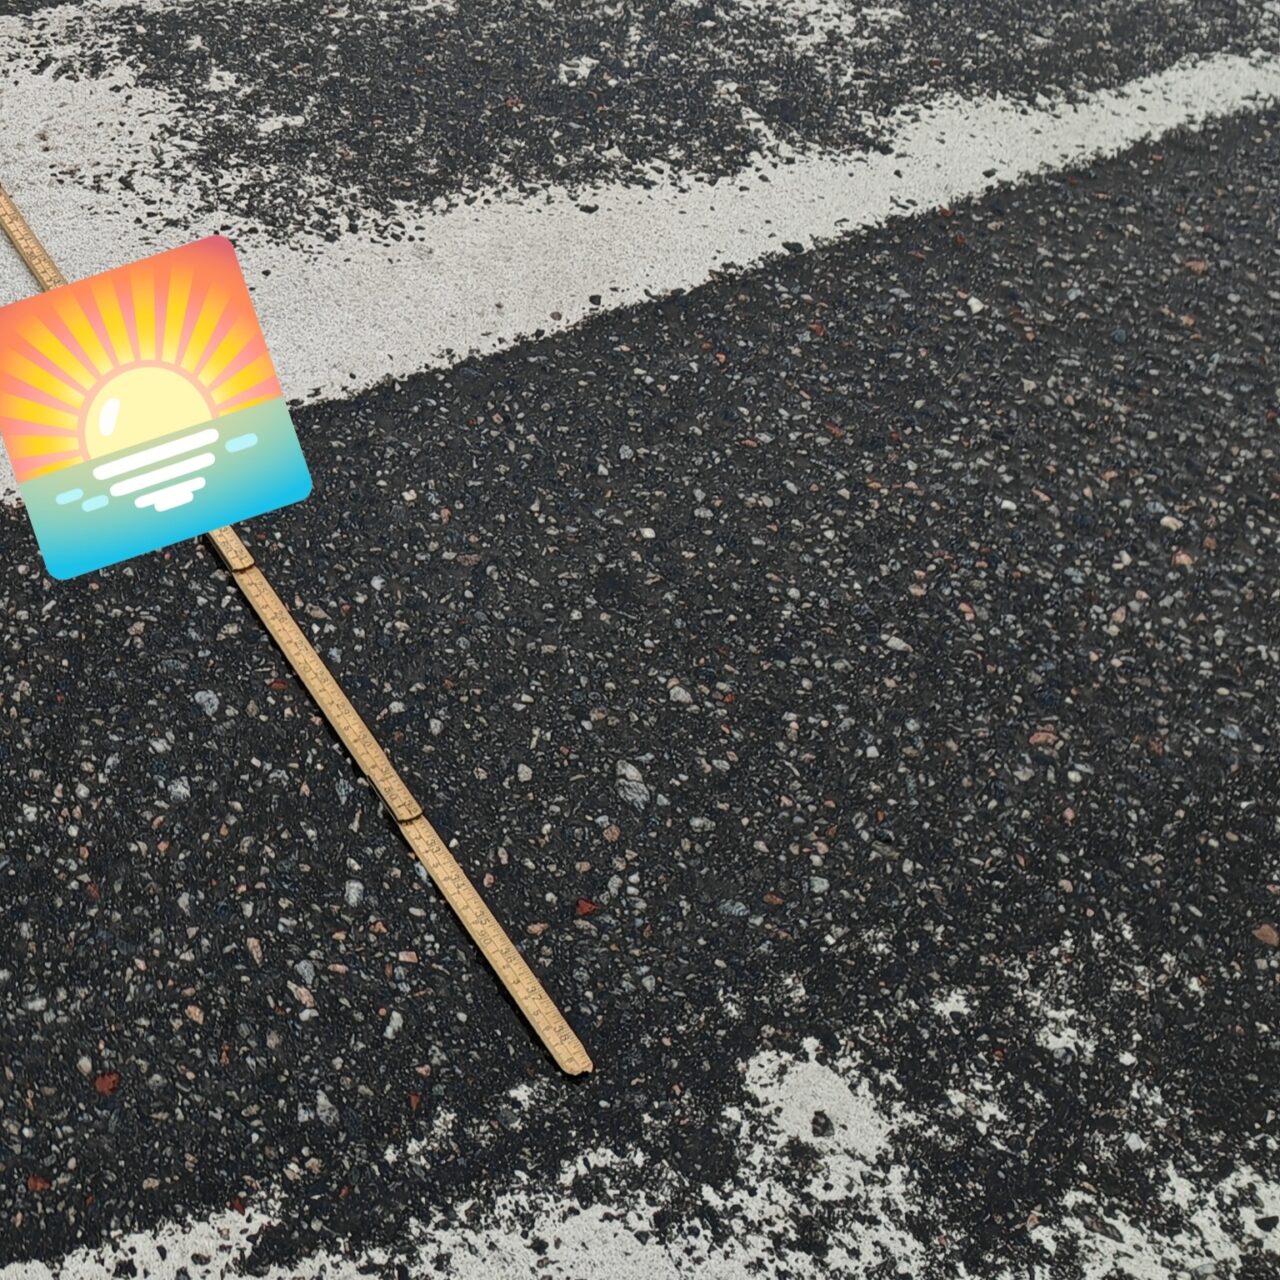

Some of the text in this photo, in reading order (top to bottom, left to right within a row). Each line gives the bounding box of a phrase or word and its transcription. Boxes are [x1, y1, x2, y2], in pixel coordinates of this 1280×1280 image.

[426, 837, 440, 853] 33
[450, 873, 464, 889] 34
[474, 909, 489, 925] 35
[500, 946, 515, 963] 36
[526, 985, 542, 1002] 37
[553, 1024, 569, 1042] 38
[477, 929, 492, 945] 90
